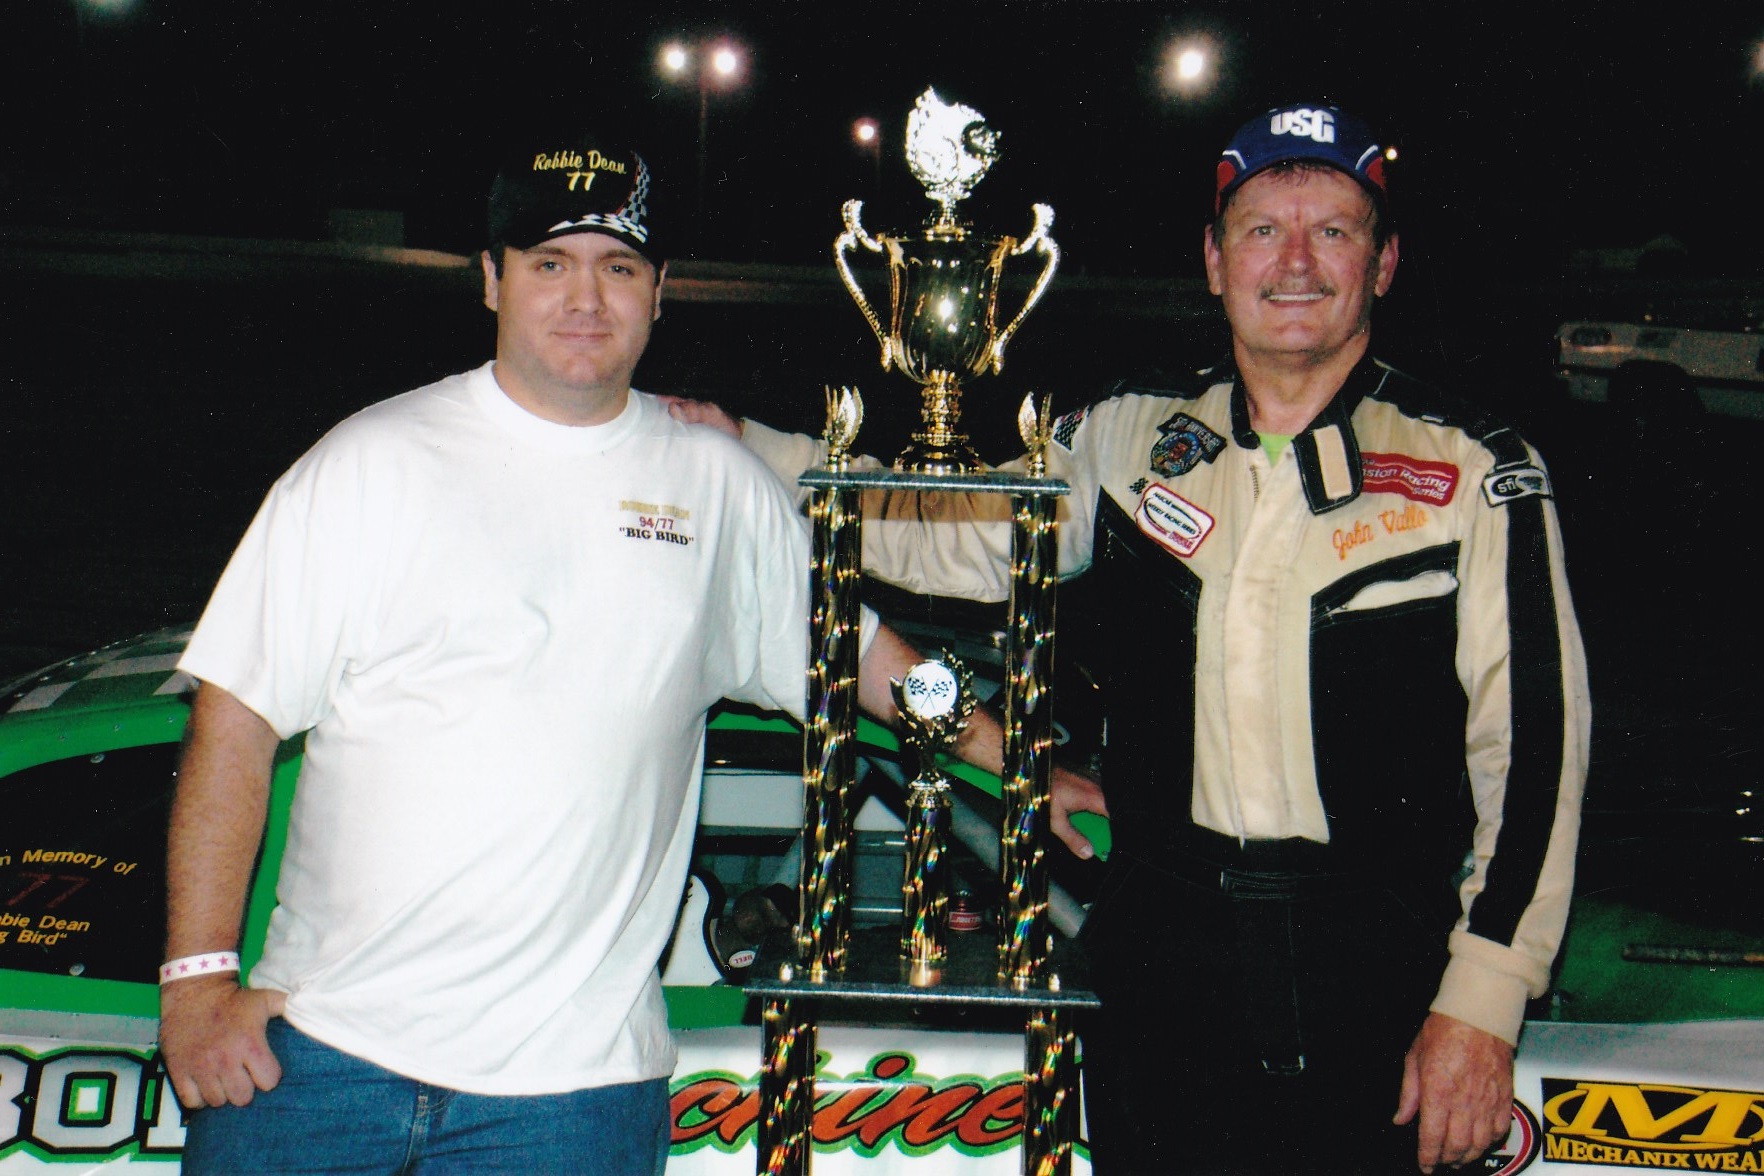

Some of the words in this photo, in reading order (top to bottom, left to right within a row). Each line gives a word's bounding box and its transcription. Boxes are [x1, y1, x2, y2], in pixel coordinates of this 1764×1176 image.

[1270, 108, 1335, 144] USG
[533, 150, 584, 171] Robbie
[588, 149, 627, 174] Dean
[566, 171, 596, 191] 77
[1400, 468, 1452, 492] Racing
[1412, 486, 1446, 500] Series
[639, 516, 674, 531] 94/77
[1332, 520, 1375, 560] John
[22, 848, 108, 869] Memory
[113, 861, 138, 875] of
[7, 872, 90, 909] 77
[39, 915, 91, 932] Dean
[1545, 1133, 1690, 1168] MECHANIX
[1694, 1149, 1764, 1173] WEA
